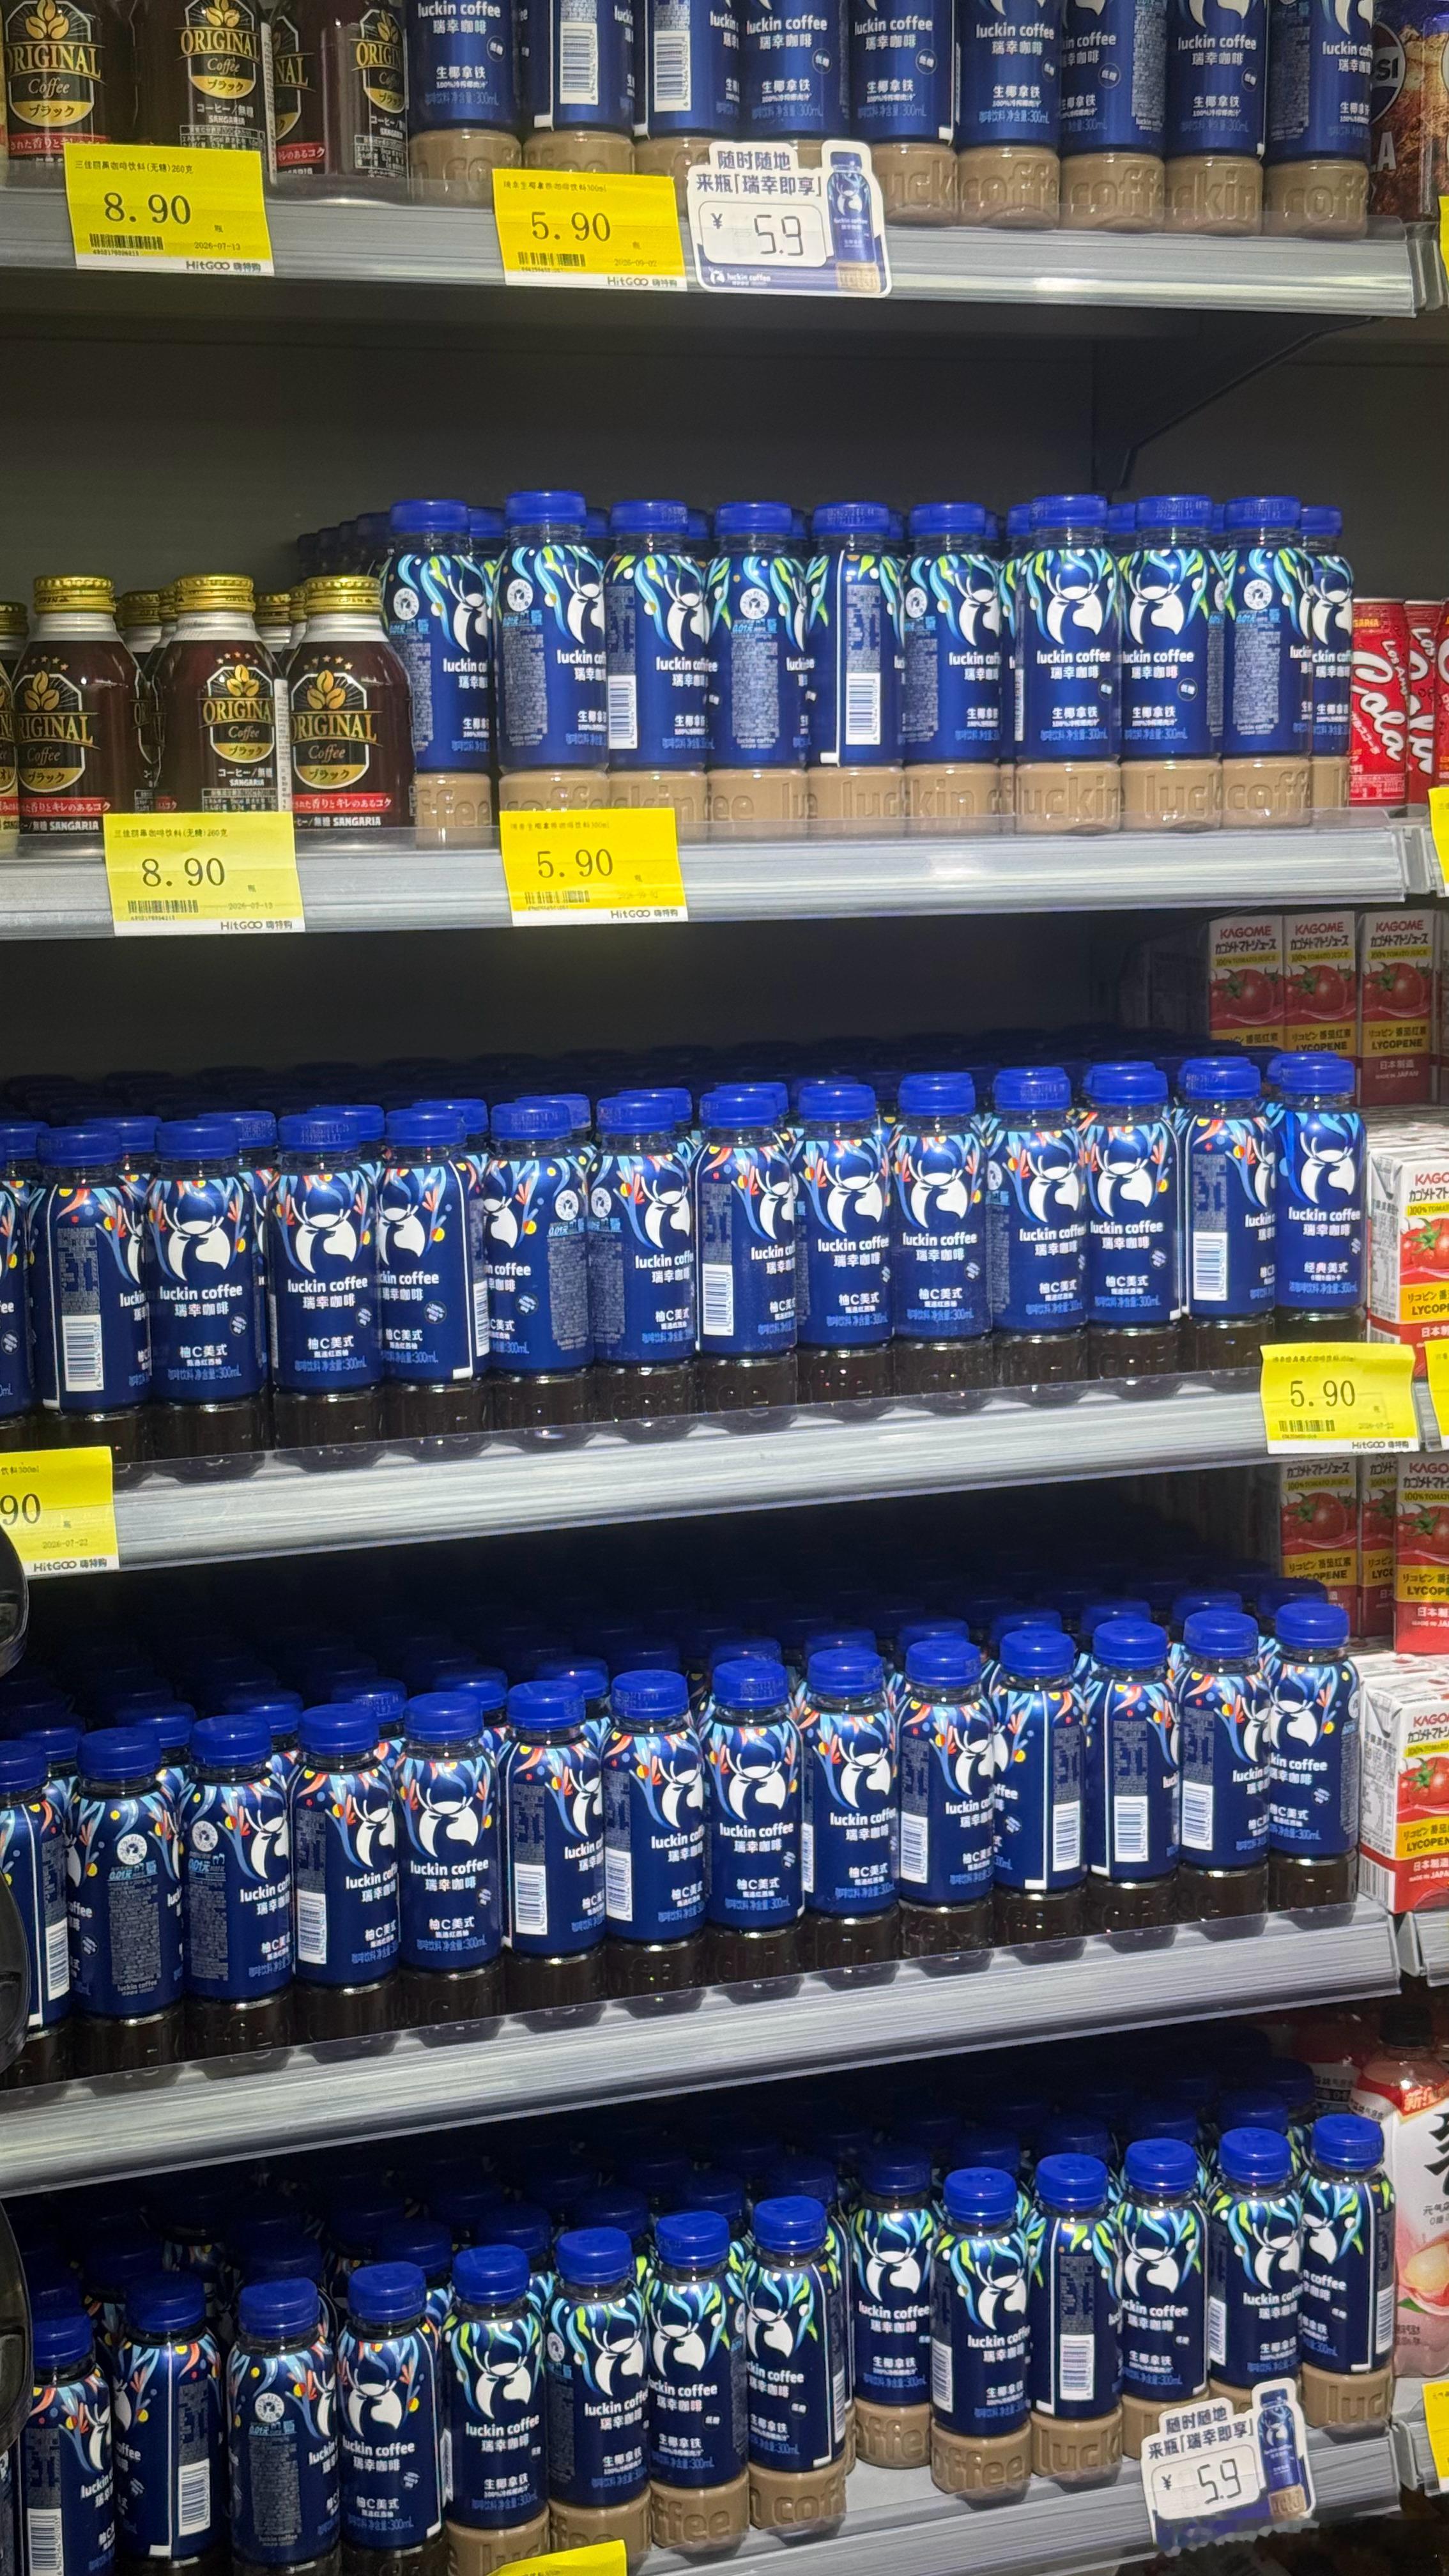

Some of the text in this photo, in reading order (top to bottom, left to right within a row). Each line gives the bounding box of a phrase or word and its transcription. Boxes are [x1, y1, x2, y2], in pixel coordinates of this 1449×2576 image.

[418, 1, 501, 18] luckin coffee
[433, 20, 487, 34] 瑞幸咖啡
[747, 15, 827, 34] luckin coffee
[976, 22, 1054, 40] luckin coffee
[760, 33, 812, 50] 瑞幸咖啡
[992, 41, 1043, 55] 瑞幸咖啡
[1178, 34, 1257, 50] luckin coffee
[207, 57, 240, 74] Coffee
[1192, 52, 1243, 66] 瑞幸咖啡
[436, 66, 486, 80] 生椰拿铁
[28, 77, 70, 99] Coffee
[207, 81, 243, 91] ブラック
[762, 79, 810, 94] 生椰拿铁
[993, 86, 1040, 98] 生椰拿铁
[1193, 96, 1239, 108] 生椰拿铁
[29, 105, 75, 118] ブラック
[718, 151, 791, 171] 随时随地
[697, 174, 822, 197] 来瓶「瑞幸即享」
[104, 192, 191, 224] 8.90
[532, 212, 611, 241] 5.90
[754, 215, 804, 256] 5.9
[186, 261, 230, 270] HitGOO
[608, 276, 648, 286] HitGOO
[1037, 650, 1110, 664] luckin coffee
[1123, 648, 1194, 664] luckin coffee
[1050, 666, 1098, 680] 瑞幸咖啡
[1131, 666, 1178, 679] 瑞幸咖啡
[203, 701, 274, 723] ORIGINA
[1132, 706, 1176, 719] 生椰拿铁
[228, 726, 259, 741] Coffee
[27, 747, 61, 765] Coffee
[229, 747, 263, 756] ブラック
[309, 745, 346, 762] Coffee
[27, 772, 65, 783] ブラック
[218, 768, 273, 778] コーヒー/無糖
[309, 769, 349, 780] ブラック
[50, 821, 99, 831] SANGARIA
[333, 817, 381, 825] SANGARIA
[537, 849, 613, 878] 5.90
[142, 858, 225, 887] 8.90
[611, 910, 650, 918] HitGOO
[221, 921, 263, 930] HitGOO
[1221, 926, 1271, 939] KAGOME
[1296, 923, 1344, 935] KAGOME
[1376, 920, 1423, 932] KAGOME
[1215, 939, 1276, 954] カゴメトマトジュース
[1291, 936, 1349, 949] カゴメトマトジュース
[1370, 933, 1428, 947] カゴメトマトジュース
[1372, 1039, 1422, 1050] LYCOPENE
[1289, 1208, 1360, 1222] luckin coffee
[1090, 1220, 1163, 1234] luckin coffee
[1303, 1224, 1350, 1237] 瑞幸咖啡
[818, 1236, 888, 1251] luckin coffee
[1102, 1236, 1149, 1250] 瑞幸咖啡
[834, 1253, 880, 1267] 瑞幸咖啡
[1305, 1262, 1348, 1274] 经典美式
[288, 1276, 368, 1293] luckin coffee
[1105, 1276, 1148, 1288] 柚C美式
[160, 1284, 243, 1301] luckin coffee
[839, 1292, 879, 1305] 柚C美式
[1408, 1291, 1436, 1303] リコピン
[302, 1294, 355, 1309] 瑞幸咖啡
[174, 1302, 229, 1317] 瑞幸咖啡
[307, 1336, 354, 1350] 柚C美式
[180, 1344, 227, 1358] 柚C美式
[1291, 1381, 1355, 1407] 5.90
[1404, 1492, 1423, 1501] 100%
[34, 1561, 76, 1572] HitGOO
[1403, 1575, 1434, 1583] リコピン
[719, 1822, 793, 1837] luckin coffee
[734, 1839, 781, 1853] 瑞幸咖啡
[410, 1859, 488, 1874] luckin coffee
[425, 1877, 476, 1891] 瑞幸咖啡
[737, 1877, 780, 1890] 柚C美式
[429, 1917, 475, 1929] 柚C美式
[859, 2302, 930, 2318] luckin coffee
[1151, 2304, 1188, 2317] coffee
[870, 2321, 917, 2332] 瑞幸咖啡
[1128, 2318, 1174, 2331] 瑞幸咖啡
[873, 2356, 917, 2368] 生椰拿铁
[1130, 2351, 1171, 2364] 生椰拿铁
[466, 2415, 539, 2437] luckin coffee
[1166, 2406, 1227, 2434] 随时随地
[343, 2440, 415, 2456] luckin coffee
[481, 2436, 530, 2452] 瑞幸咖啡
[354, 2456, 400, 2471] 瑞幸咖啡
[484, 2474, 528, 2490] 生椰拿铁
[1197, 2458, 1241, 2504] 5.9
[356, 2497, 399, 2510] 柚C美式
